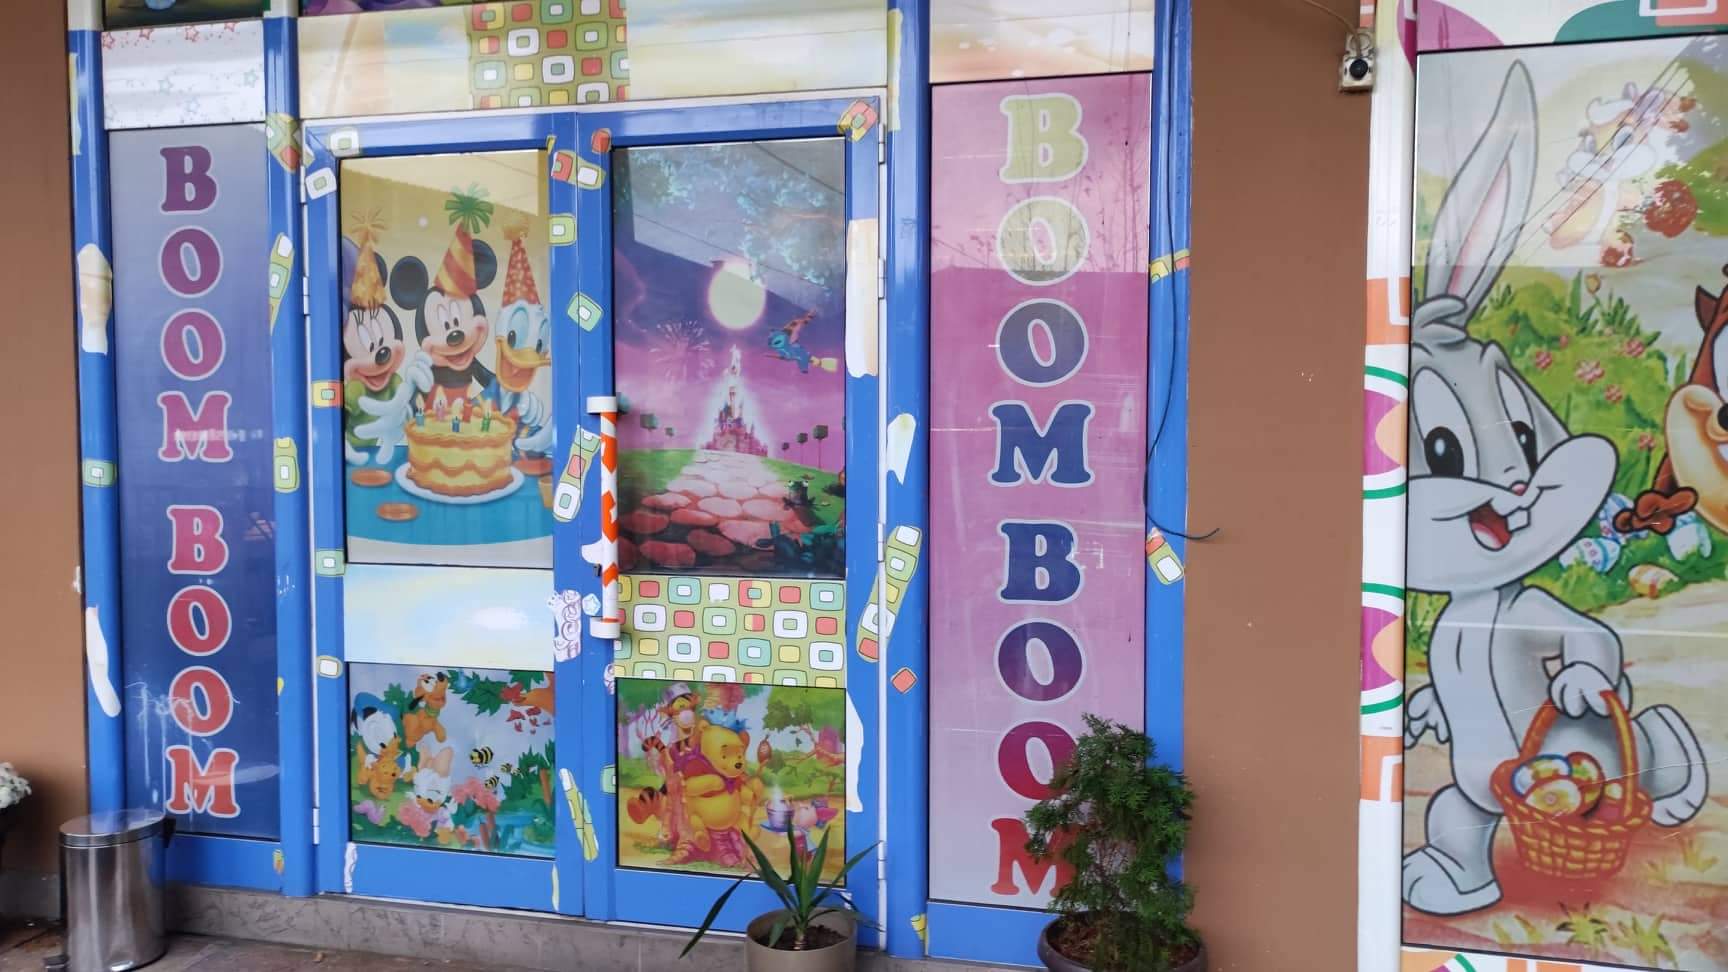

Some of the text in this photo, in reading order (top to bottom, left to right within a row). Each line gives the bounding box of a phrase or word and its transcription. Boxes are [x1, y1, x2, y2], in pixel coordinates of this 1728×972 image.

[157, 145, 232, 462] BOOM
[989, 93, 1095, 899] BOOM BOOM
[166, 504, 240, 818] BOOM
